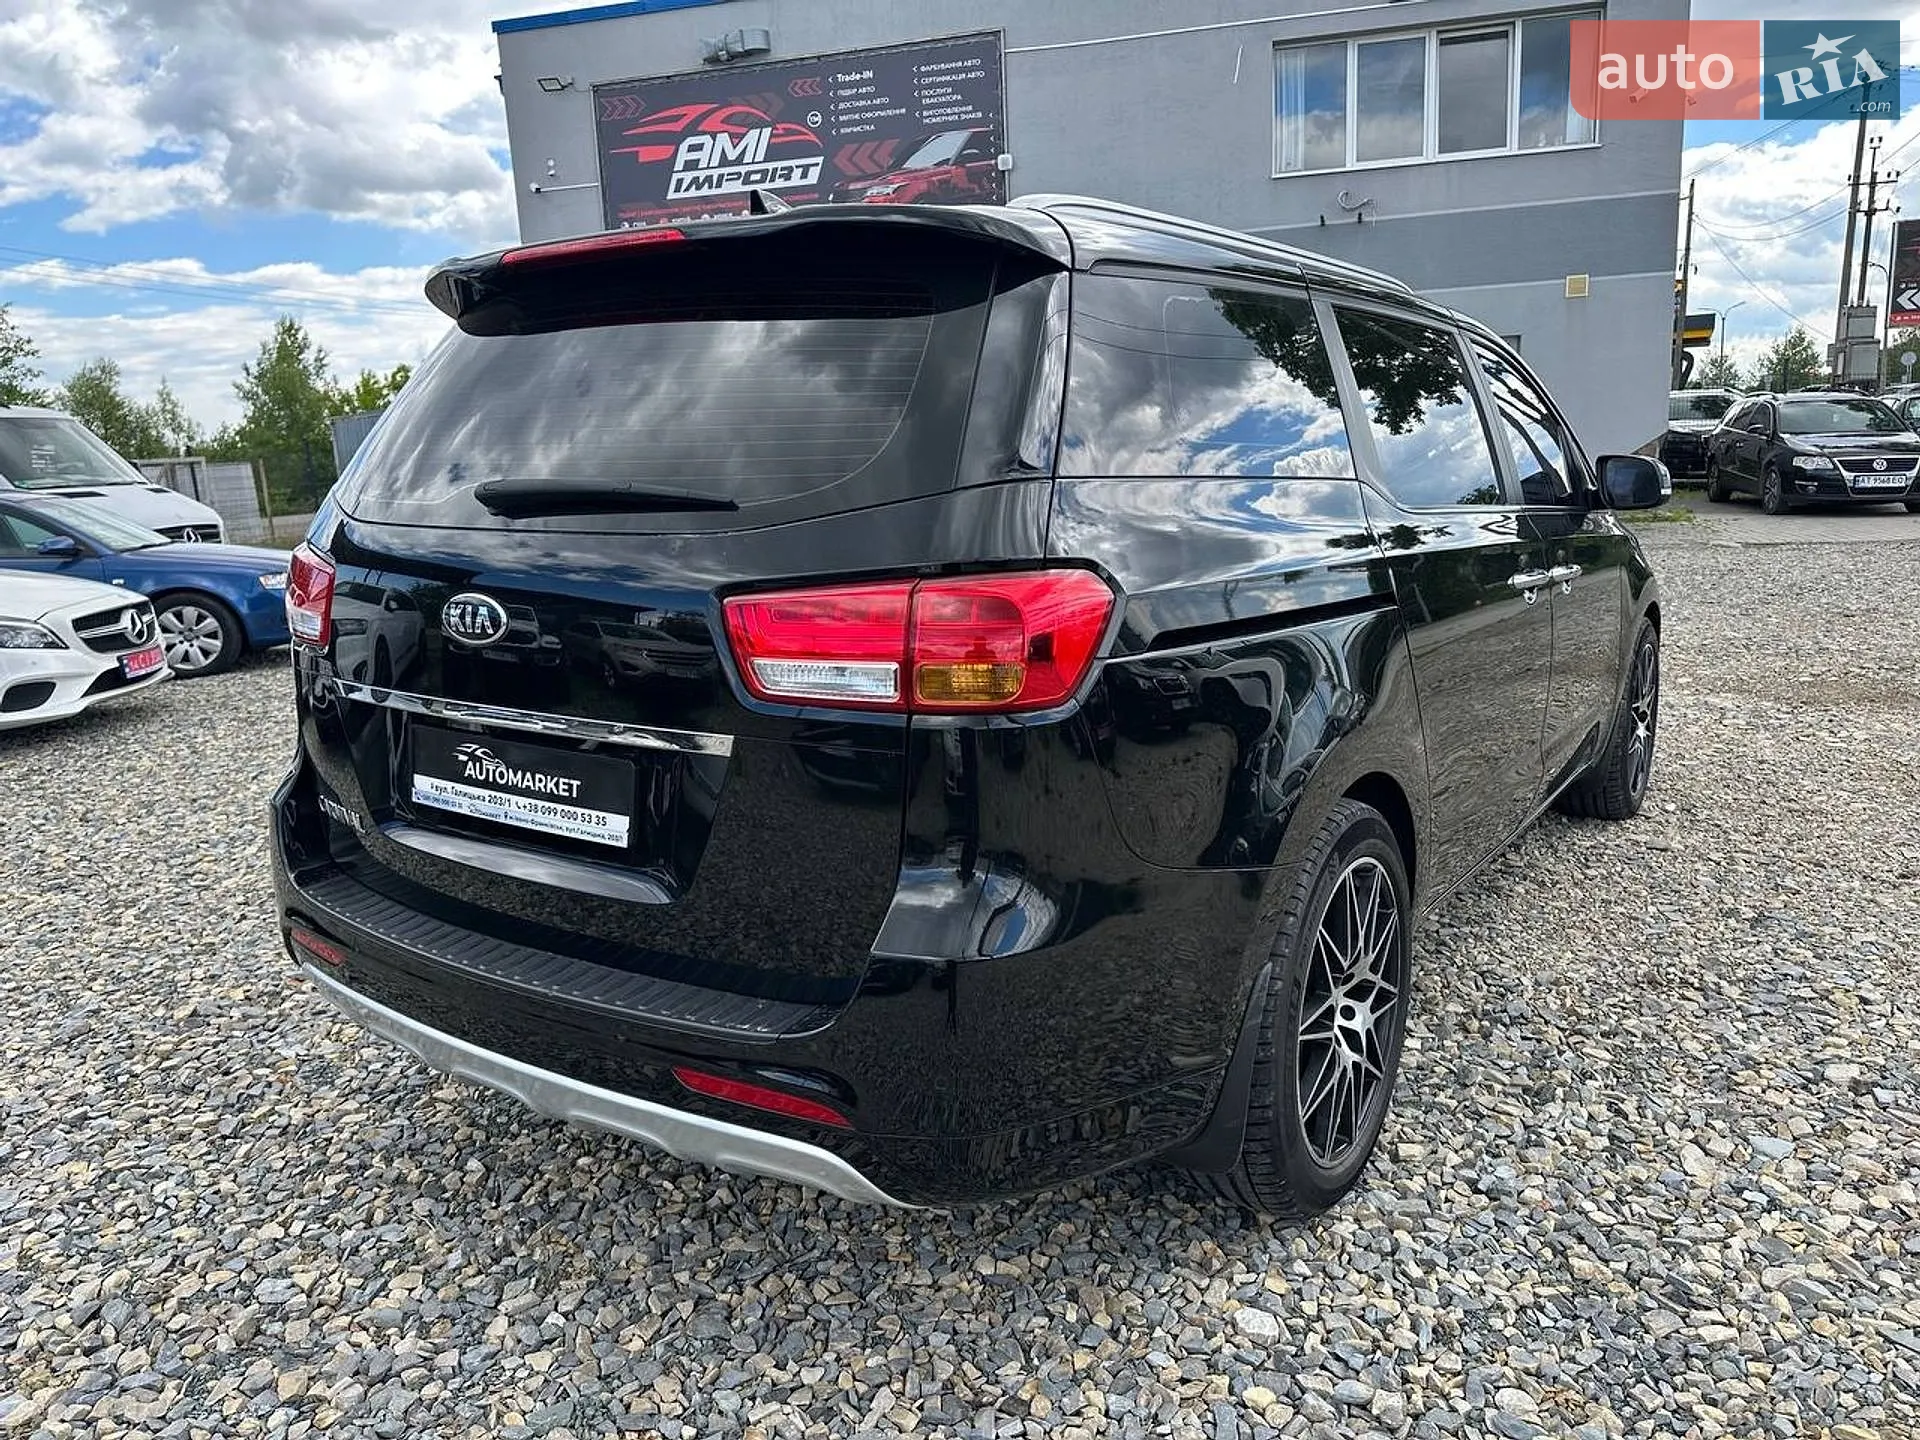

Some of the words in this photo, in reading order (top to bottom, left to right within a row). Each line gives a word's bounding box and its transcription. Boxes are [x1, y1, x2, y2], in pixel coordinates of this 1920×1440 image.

[963, 58, 981, 67] АВТО
[836, 69, 873, 82] Trade-IN
[967, 70, 985, 78] АВТО
[858, 85, 876, 94] АВТО
[921, 87, 952, 96] ПОСЛУГИ
[839, 100, 872, 109] ДОСТАВКА
[872, 97, 889, 105] АВТО
[673, 127, 772, 171] AMI
[673, 162, 819, 193] IMPORT
[450, 604, 494, 634] KIA
[464, 760, 581, 798] AUTOMARKET
[487, 794, 511, 808] 203/1
[522, 802, 539, 814] +38
[540, 805, 558, 817] 099
[560, 809, 579, 821] 000
[580, 812, 592, 825] 53
[594, 815, 607, 827] 35
